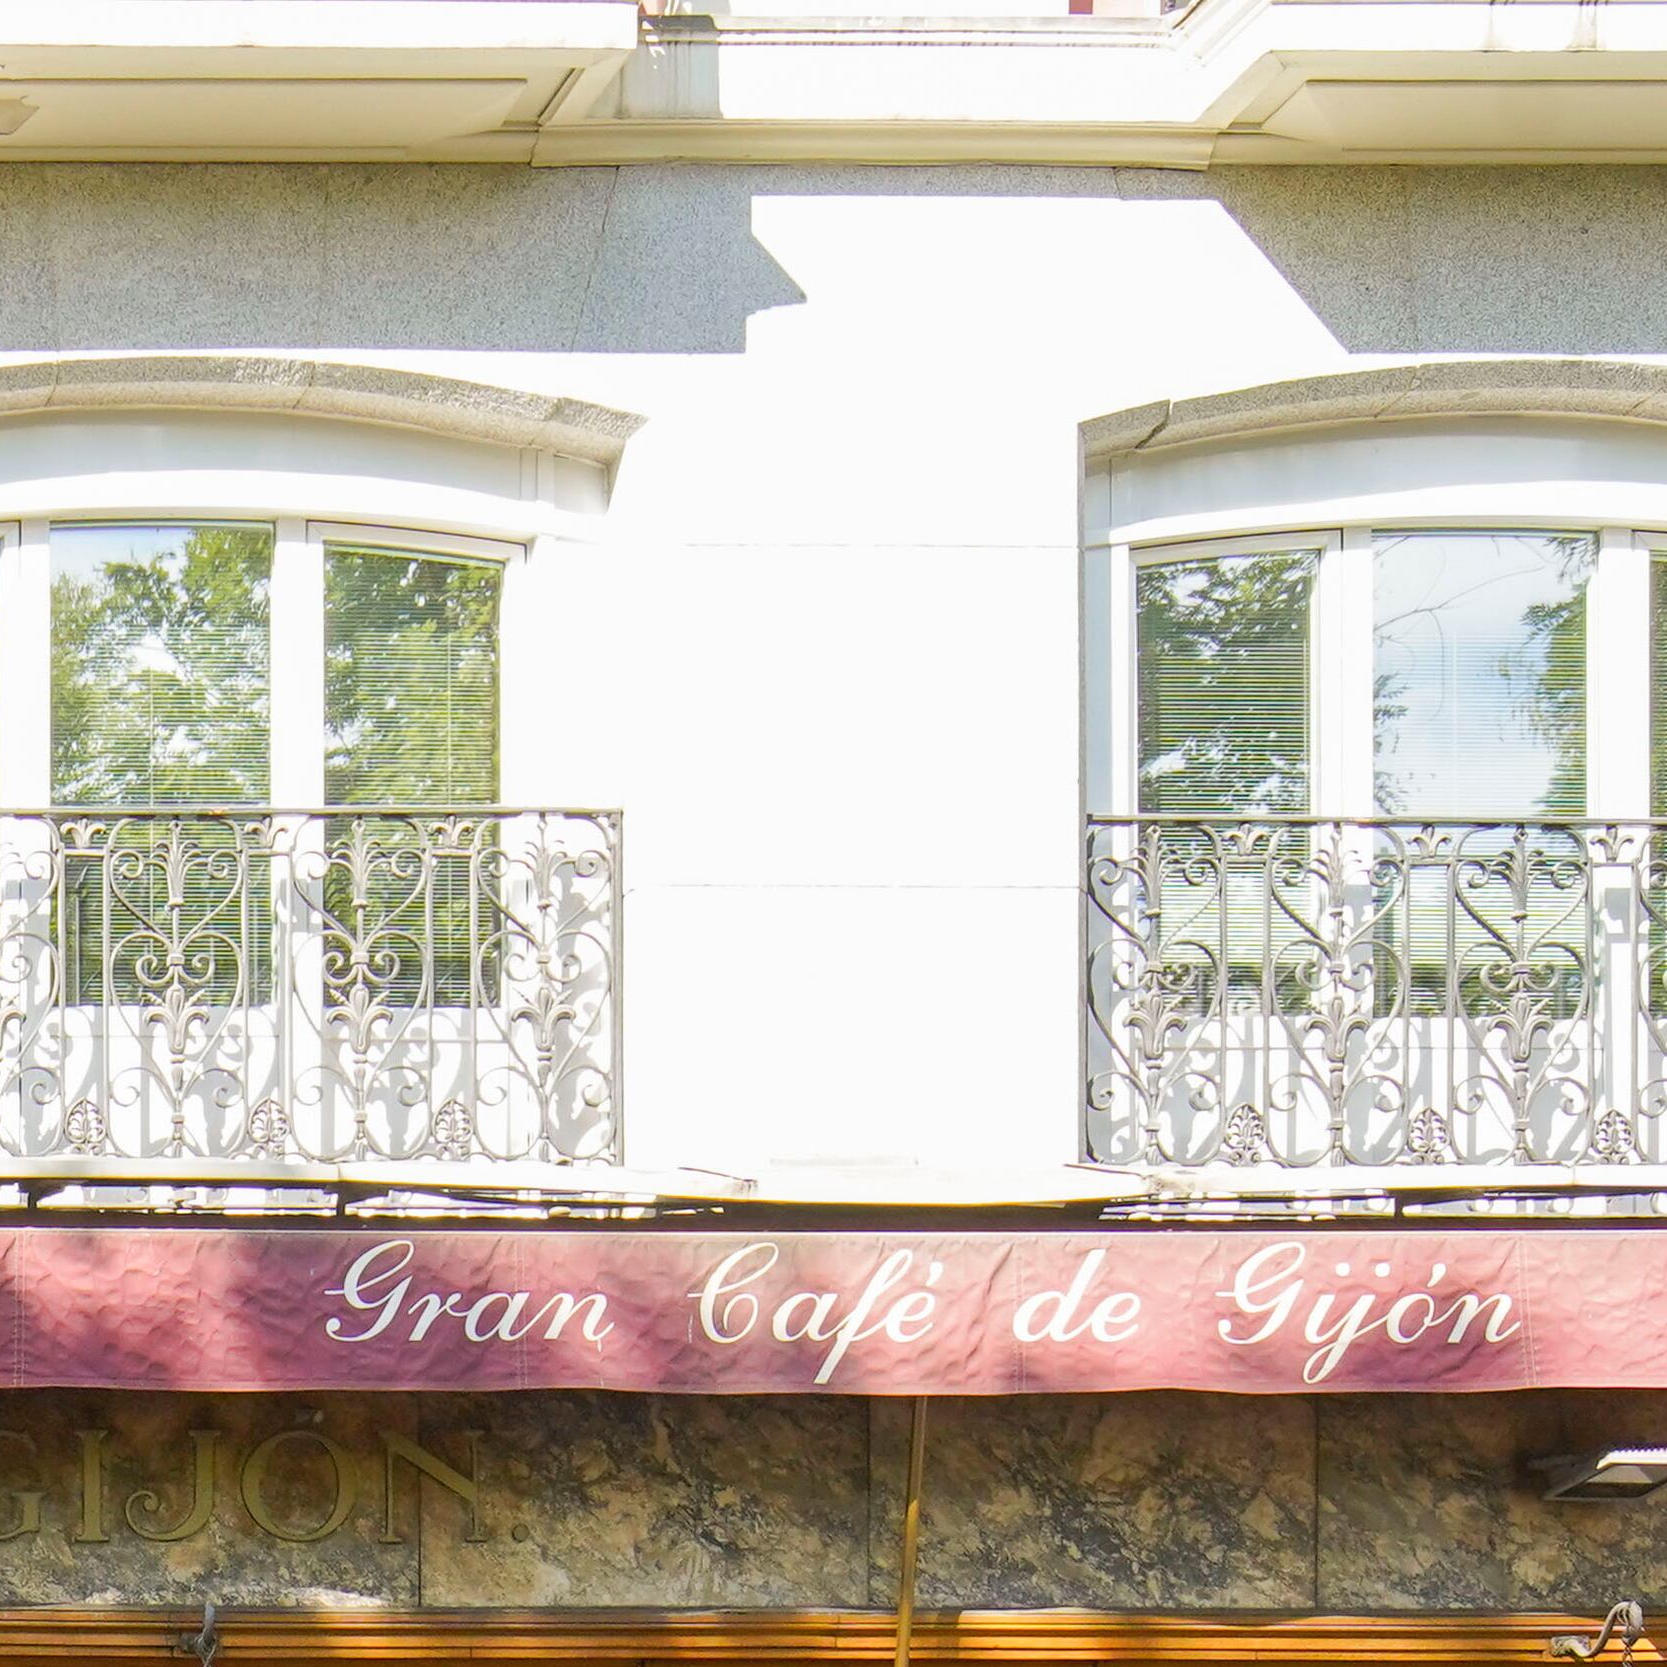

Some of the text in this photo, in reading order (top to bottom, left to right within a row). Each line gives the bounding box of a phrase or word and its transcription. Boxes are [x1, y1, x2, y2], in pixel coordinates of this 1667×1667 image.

[324, 1240, 1522, 1384] Gran Café de Gijón
